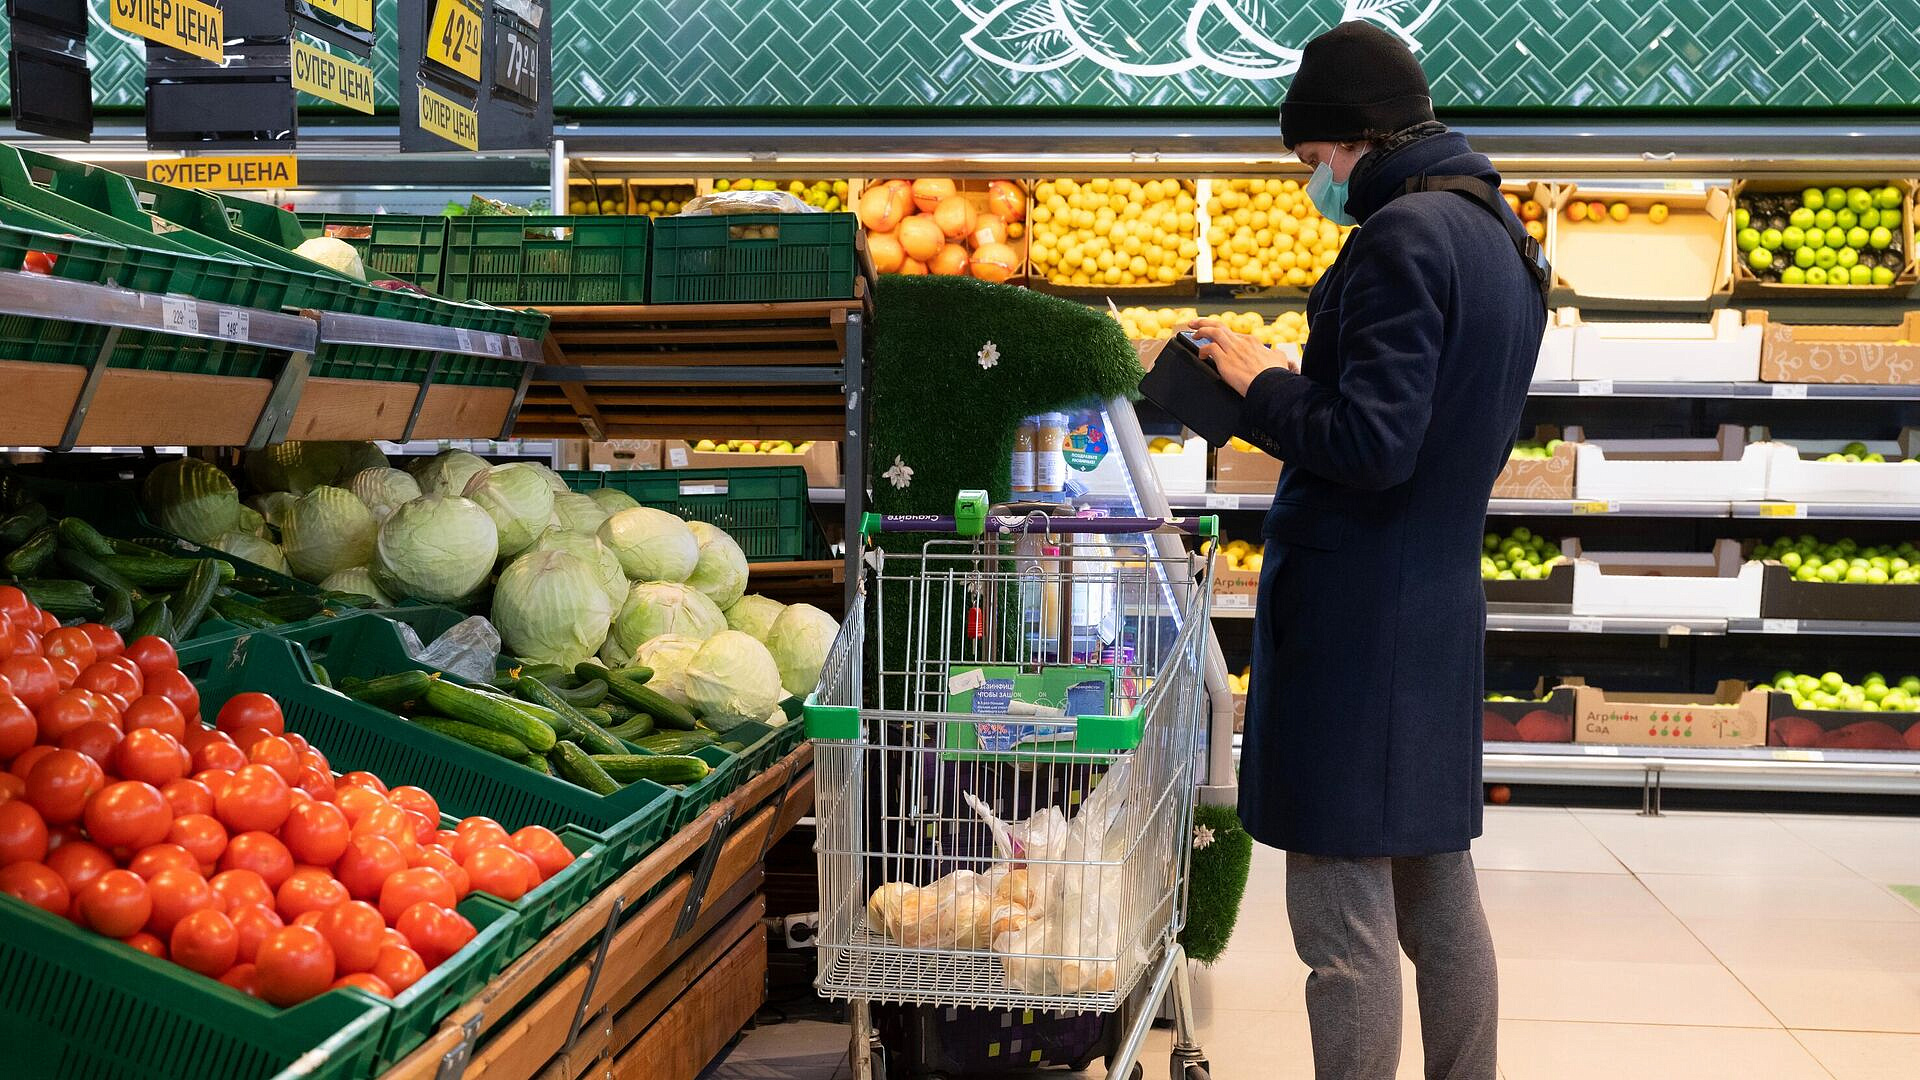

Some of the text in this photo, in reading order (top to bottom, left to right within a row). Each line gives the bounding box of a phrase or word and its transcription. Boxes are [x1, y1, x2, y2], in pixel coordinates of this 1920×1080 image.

[176, 3, 219, 50] ЦЕНА
[295, 49, 371, 104] СУПЕР ЦЕНА
[422, 94, 476, 143] СУПЕР ЦЕНА
[152, 161, 289, 185] СУПЕР ЦЕНА
[887, 514, 939, 522] Скачайте
[1586, 723, 1610, 734] Сад
